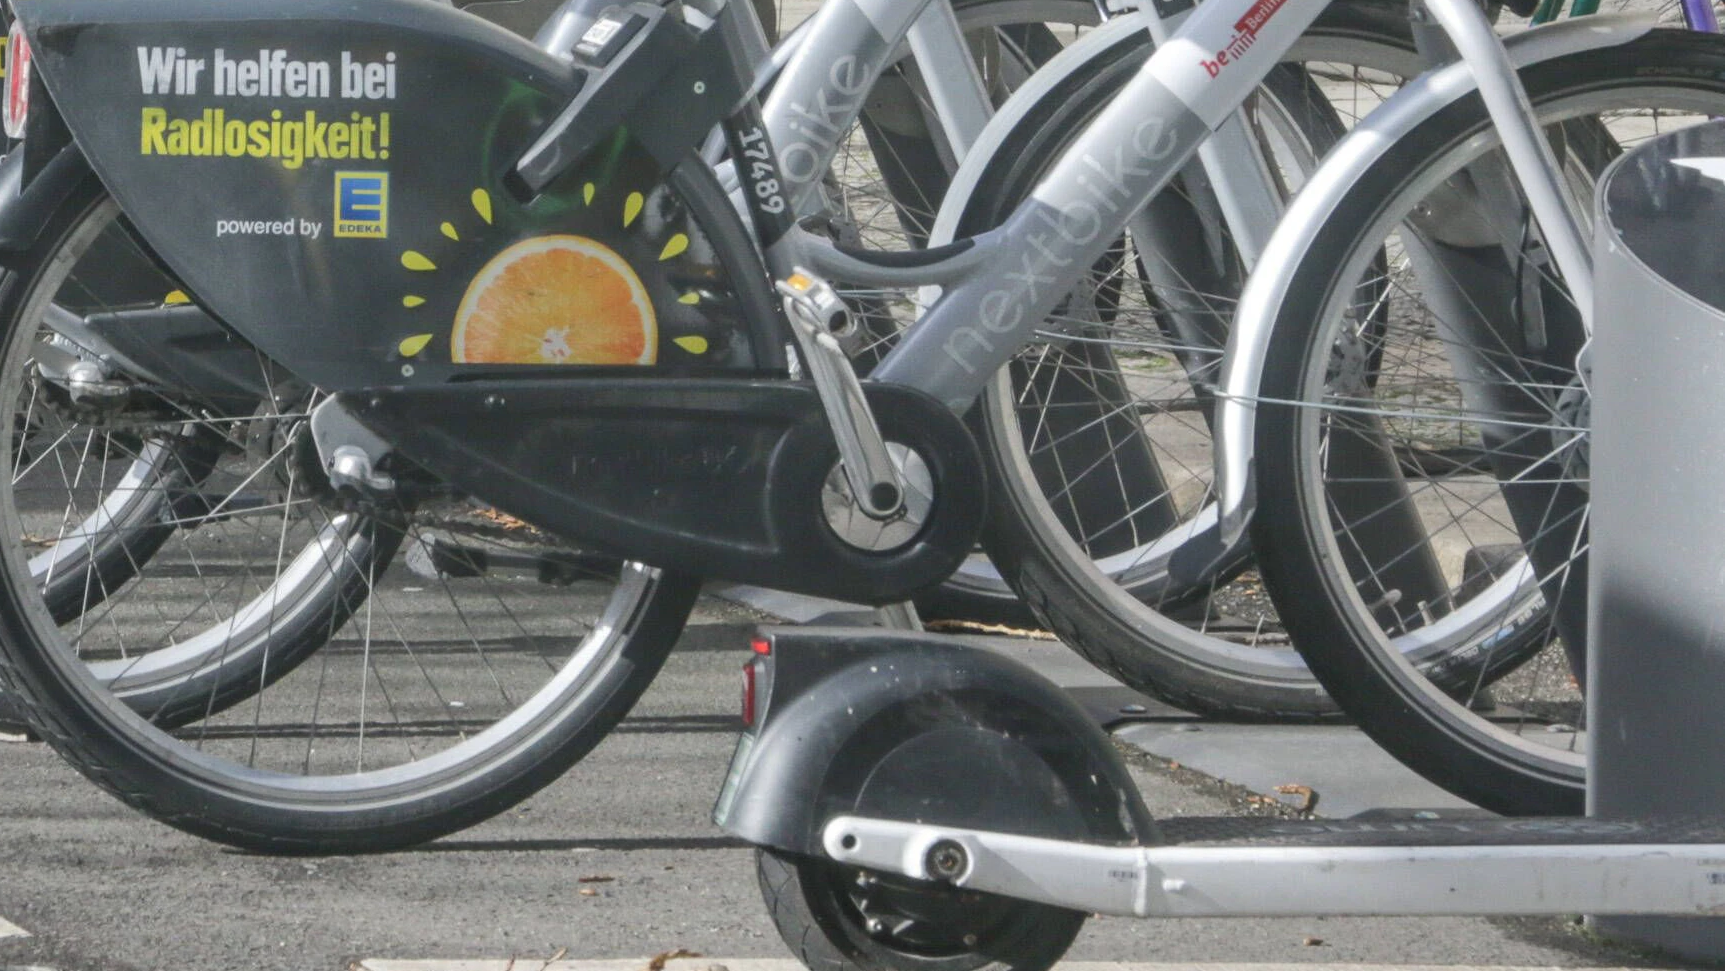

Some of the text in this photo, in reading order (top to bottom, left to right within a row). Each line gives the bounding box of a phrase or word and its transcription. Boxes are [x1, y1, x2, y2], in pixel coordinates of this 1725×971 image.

[137, 46, 397, 100] Wir helfen bei
[1200, 48, 1229, 79] be
[141, 106, 390, 170] Radlosigkeit!
[738, 126, 785, 214] 17489
[216, 218, 322, 239] powered by
[338, 223, 383, 234] EDEKA
[942, 116, 1177, 375] nextbike
